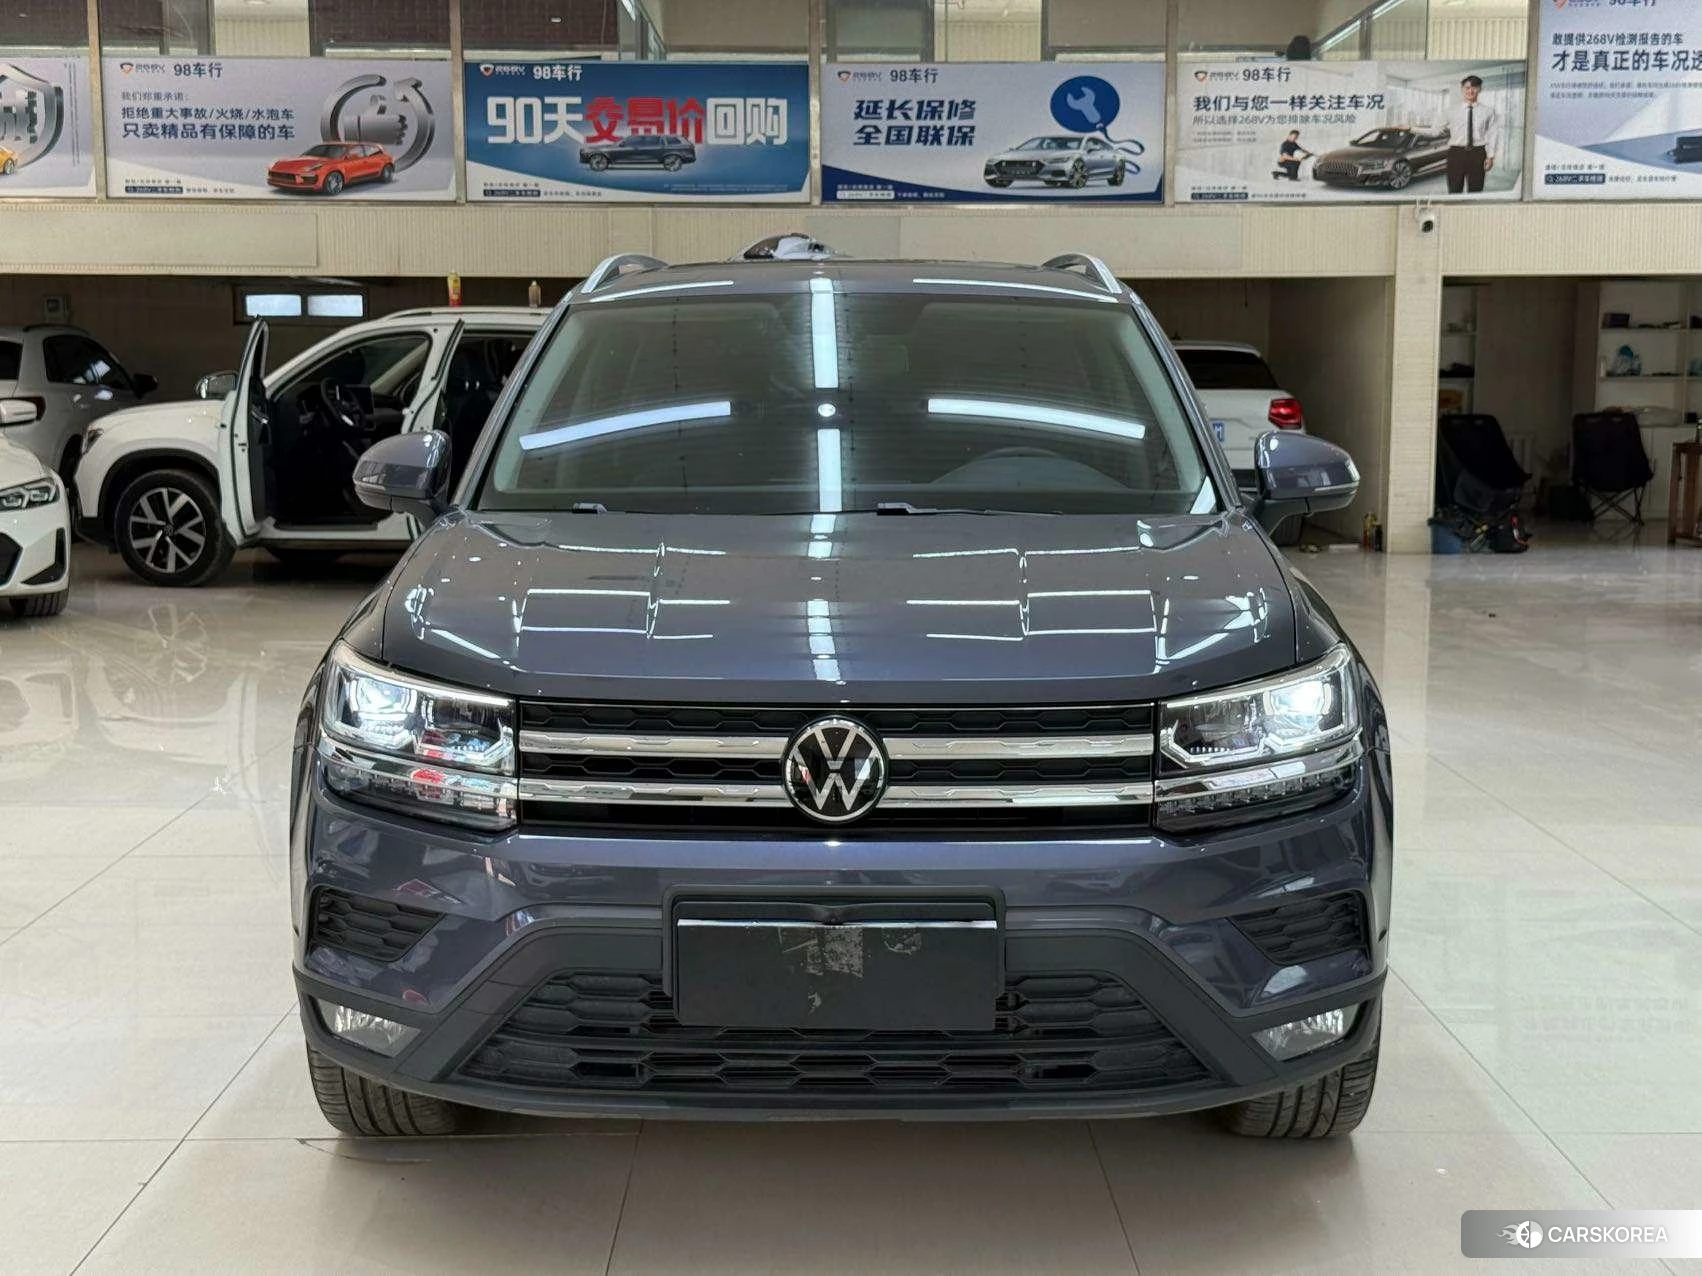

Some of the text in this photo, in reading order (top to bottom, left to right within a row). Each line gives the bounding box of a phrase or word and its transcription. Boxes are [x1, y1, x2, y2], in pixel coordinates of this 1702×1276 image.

[173, 62, 223, 78] 98车行
[533, 64, 583, 81] 98车行
[889, 67, 939, 83] 98车行
[1242, 67, 1291, 82] 98车行
[853, 99, 976, 121] 延长保修
[1192, 94, 1385, 112] 我们与您一样关注车况
[121, 107, 296, 120] 拒绝重大事故/火烧/水泡车
[122, 123, 296, 140] 只卖精品有保障的车
[853, 124, 976, 146] 全国联保
